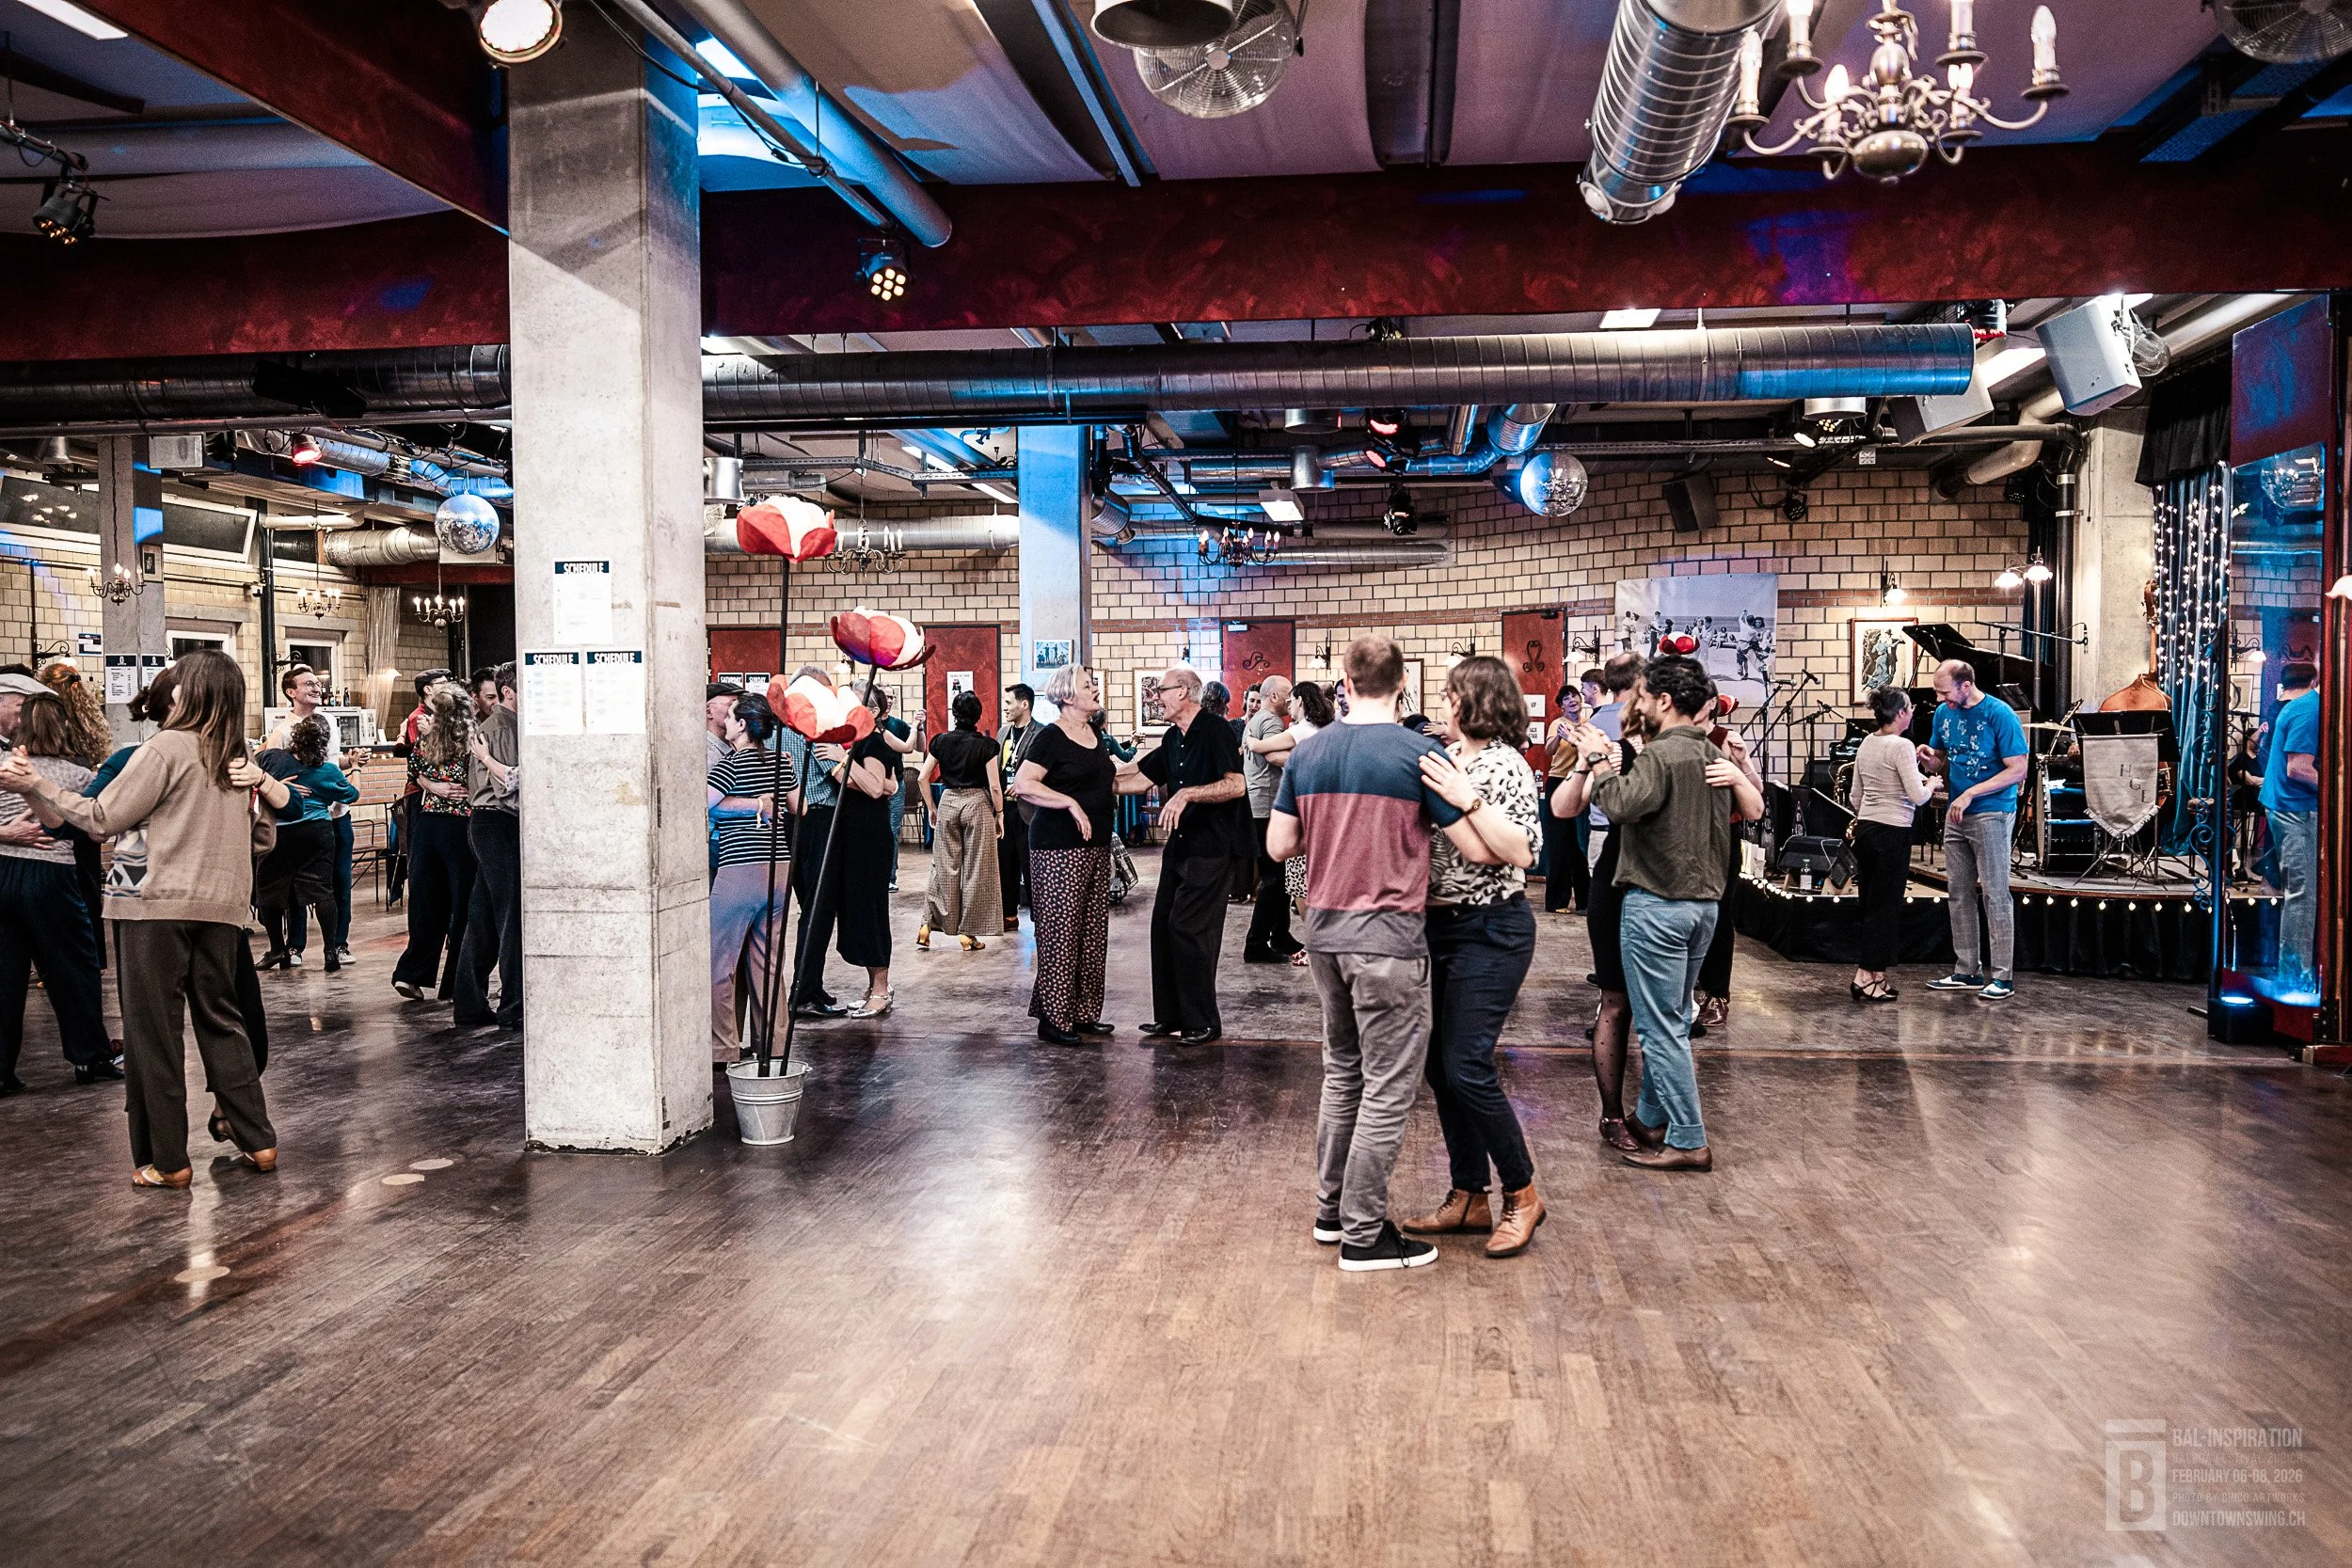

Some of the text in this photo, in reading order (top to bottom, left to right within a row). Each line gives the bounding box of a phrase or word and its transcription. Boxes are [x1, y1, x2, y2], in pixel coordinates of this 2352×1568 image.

[564, 562, 604, 574] SCHEDULE
[533, 654, 574, 665] SCHEDULE
[595, 652, 635, 664] SCHEDULE
